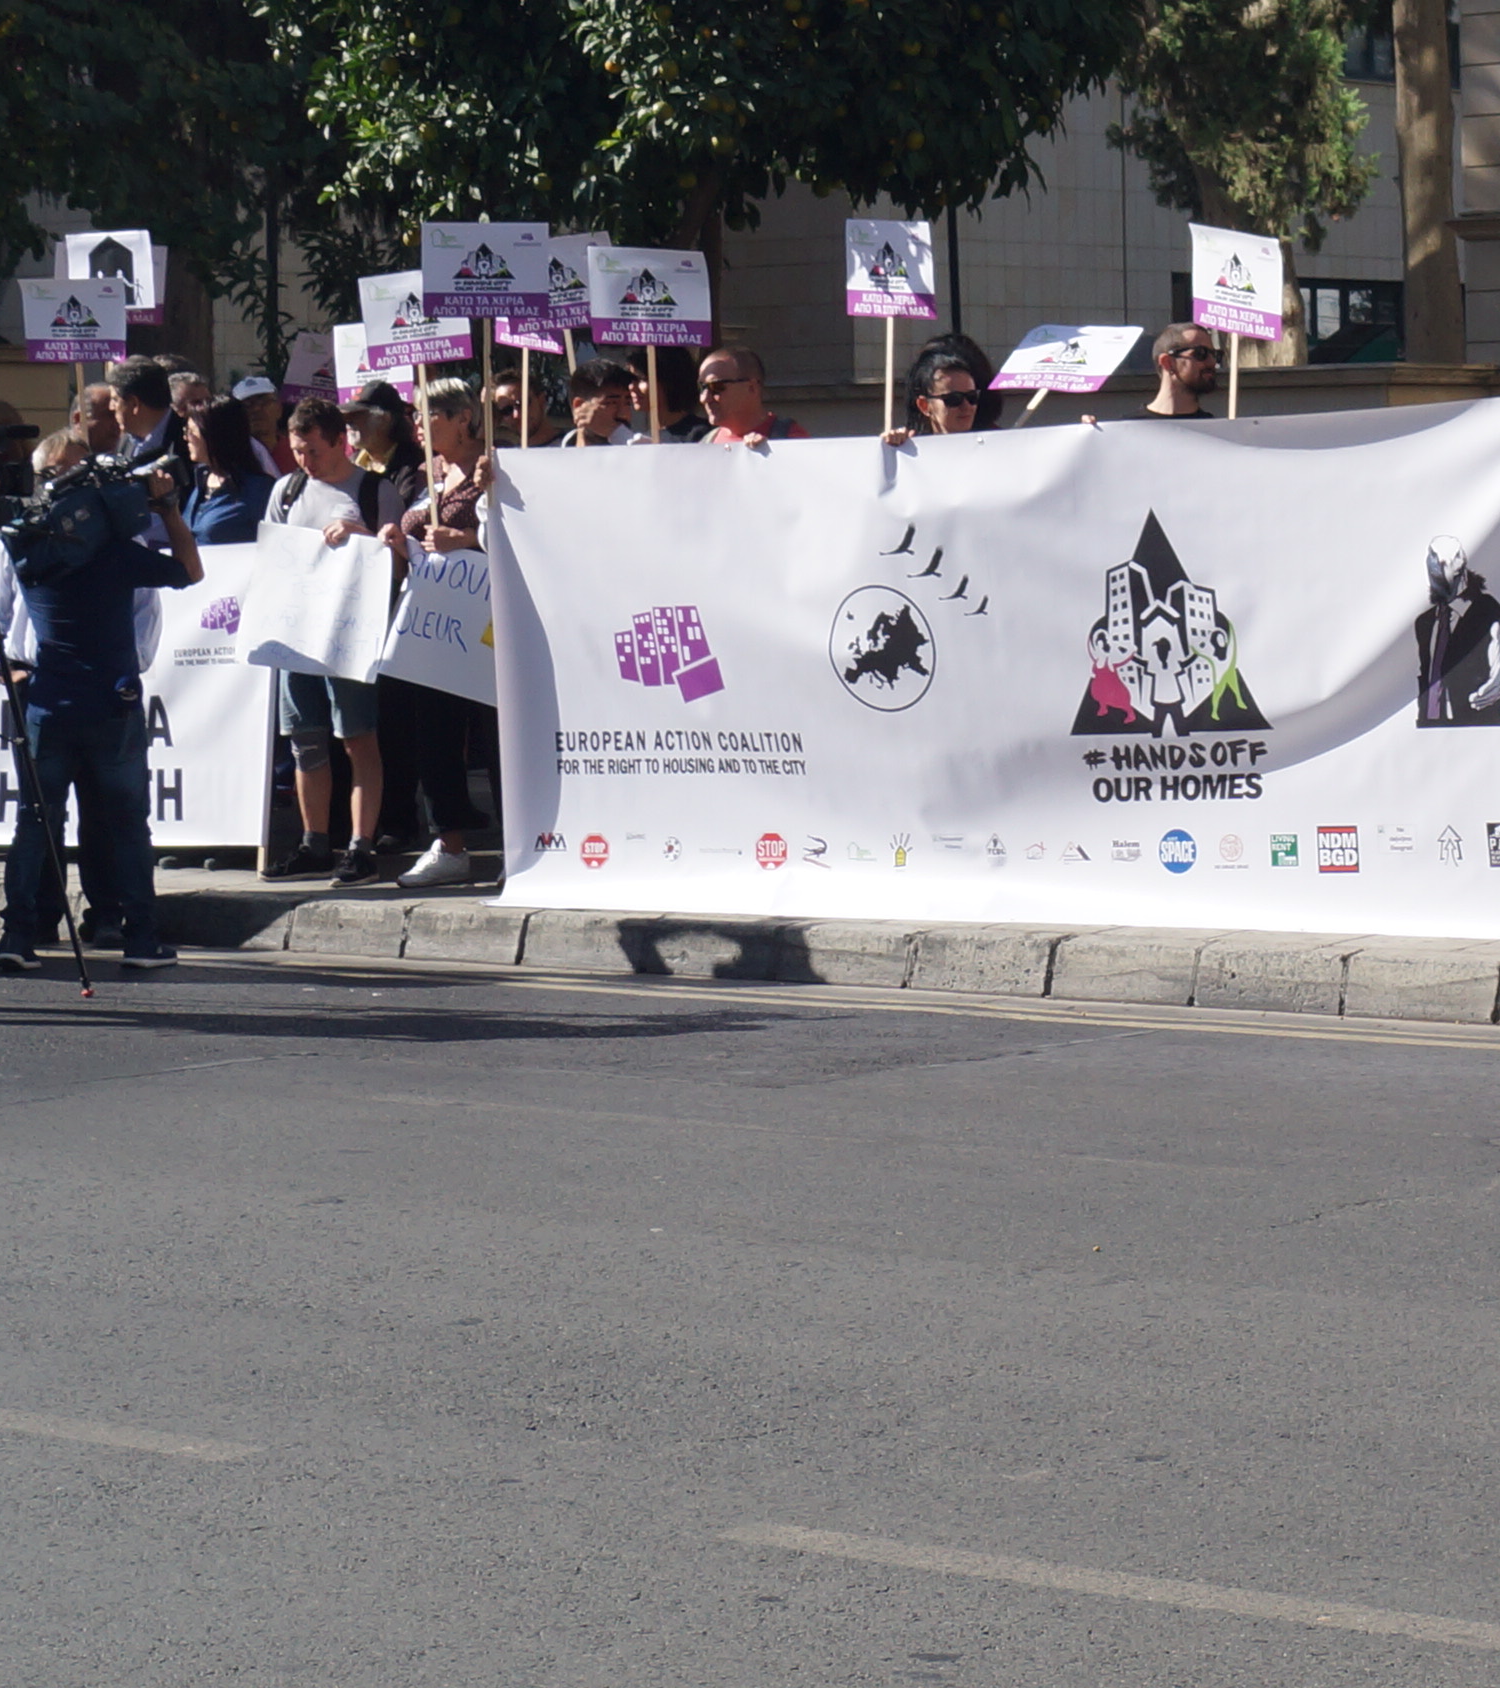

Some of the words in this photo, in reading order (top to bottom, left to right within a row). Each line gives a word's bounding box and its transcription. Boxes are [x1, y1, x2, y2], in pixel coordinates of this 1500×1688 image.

[444, 296, 473, 306] ΚΑΤΩ
[476, 296, 490, 306] ΤΑ
[492, 296, 524, 306] ΧΕΡΙΑ
[612, 322, 639, 332] ΚΑΤΩ
[641, 322, 653, 332] ΤΑ
[656, 323, 687, 333] ΧΕΡΙΑ
[601, 331, 624, 342] ΑΠΟ
[627, 332, 639, 342] ΤΑ
[641, 333, 675, 344] ΣΠΙΤΙΑ
[677, 334, 702, 344] ΜΑΣ
[385, 344, 409, 356] ΚΑΤΩ
[410, 342, 422, 353] ΤΑ
[423, 339, 451, 352] ΧΕΡΙΑ
[376, 356, 397, 367] ΑΠΟ
[399, 354, 410, 364] ΤΑ
[411, 350, 441, 363] ΣΠΙΤΙΑ
[443, 347, 465, 359] ΜΑΣ
[395, 606, 468, 653] OLEUR
[214, 646, 236, 656] ACTIO
[555, 730, 647, 753] EUROPEAN
[654, 730, 713, 752] ACTION
[717, 731, 804, 754] COALITION
[557, 758, 580, 776] FOR
[582, 758, 605, 775] THE
[608, 758, 642, 775] RIGHT
[643, 758, 660, 774] TO
[663, 758, 715, 775] HOUSING
[718, 758, 741, 775] AND
[742, 759, 758, 775] TO
[759, 759, 781, 776] THE
[783, 760, 807, 776] CITY
[1092, 776, 1153, 803] OUR
[1160, 772, 1263, 801] HOMES
[584, 841, 606, 854] STOP
[1271, 835, 1296, 843] LIVING
[1318, 832, 1357, 849] NDM
[757, 840, 786, 857] STOP
[1160, 840, 1195, 863] SPACE
[1319, 849, 1358, 866] BGD
